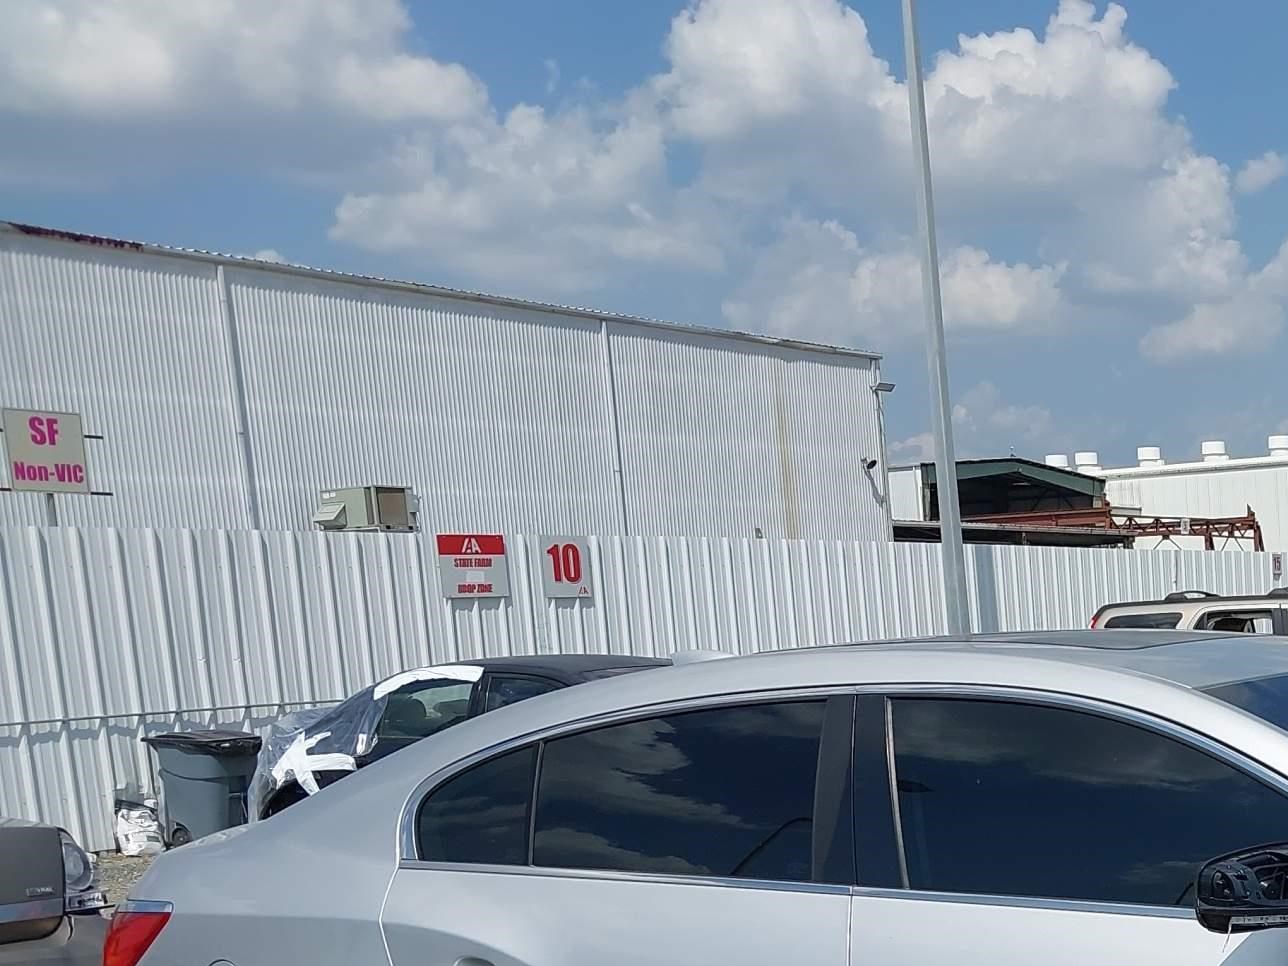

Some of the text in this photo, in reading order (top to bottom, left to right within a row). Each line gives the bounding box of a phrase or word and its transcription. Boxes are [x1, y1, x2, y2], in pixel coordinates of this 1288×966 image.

[28, 416, 59, 446] SF
[13, 461, 84, 483] Non-VIC
[453, 558, 474, 568] STATE
[546, 543, 583, 583] 10
